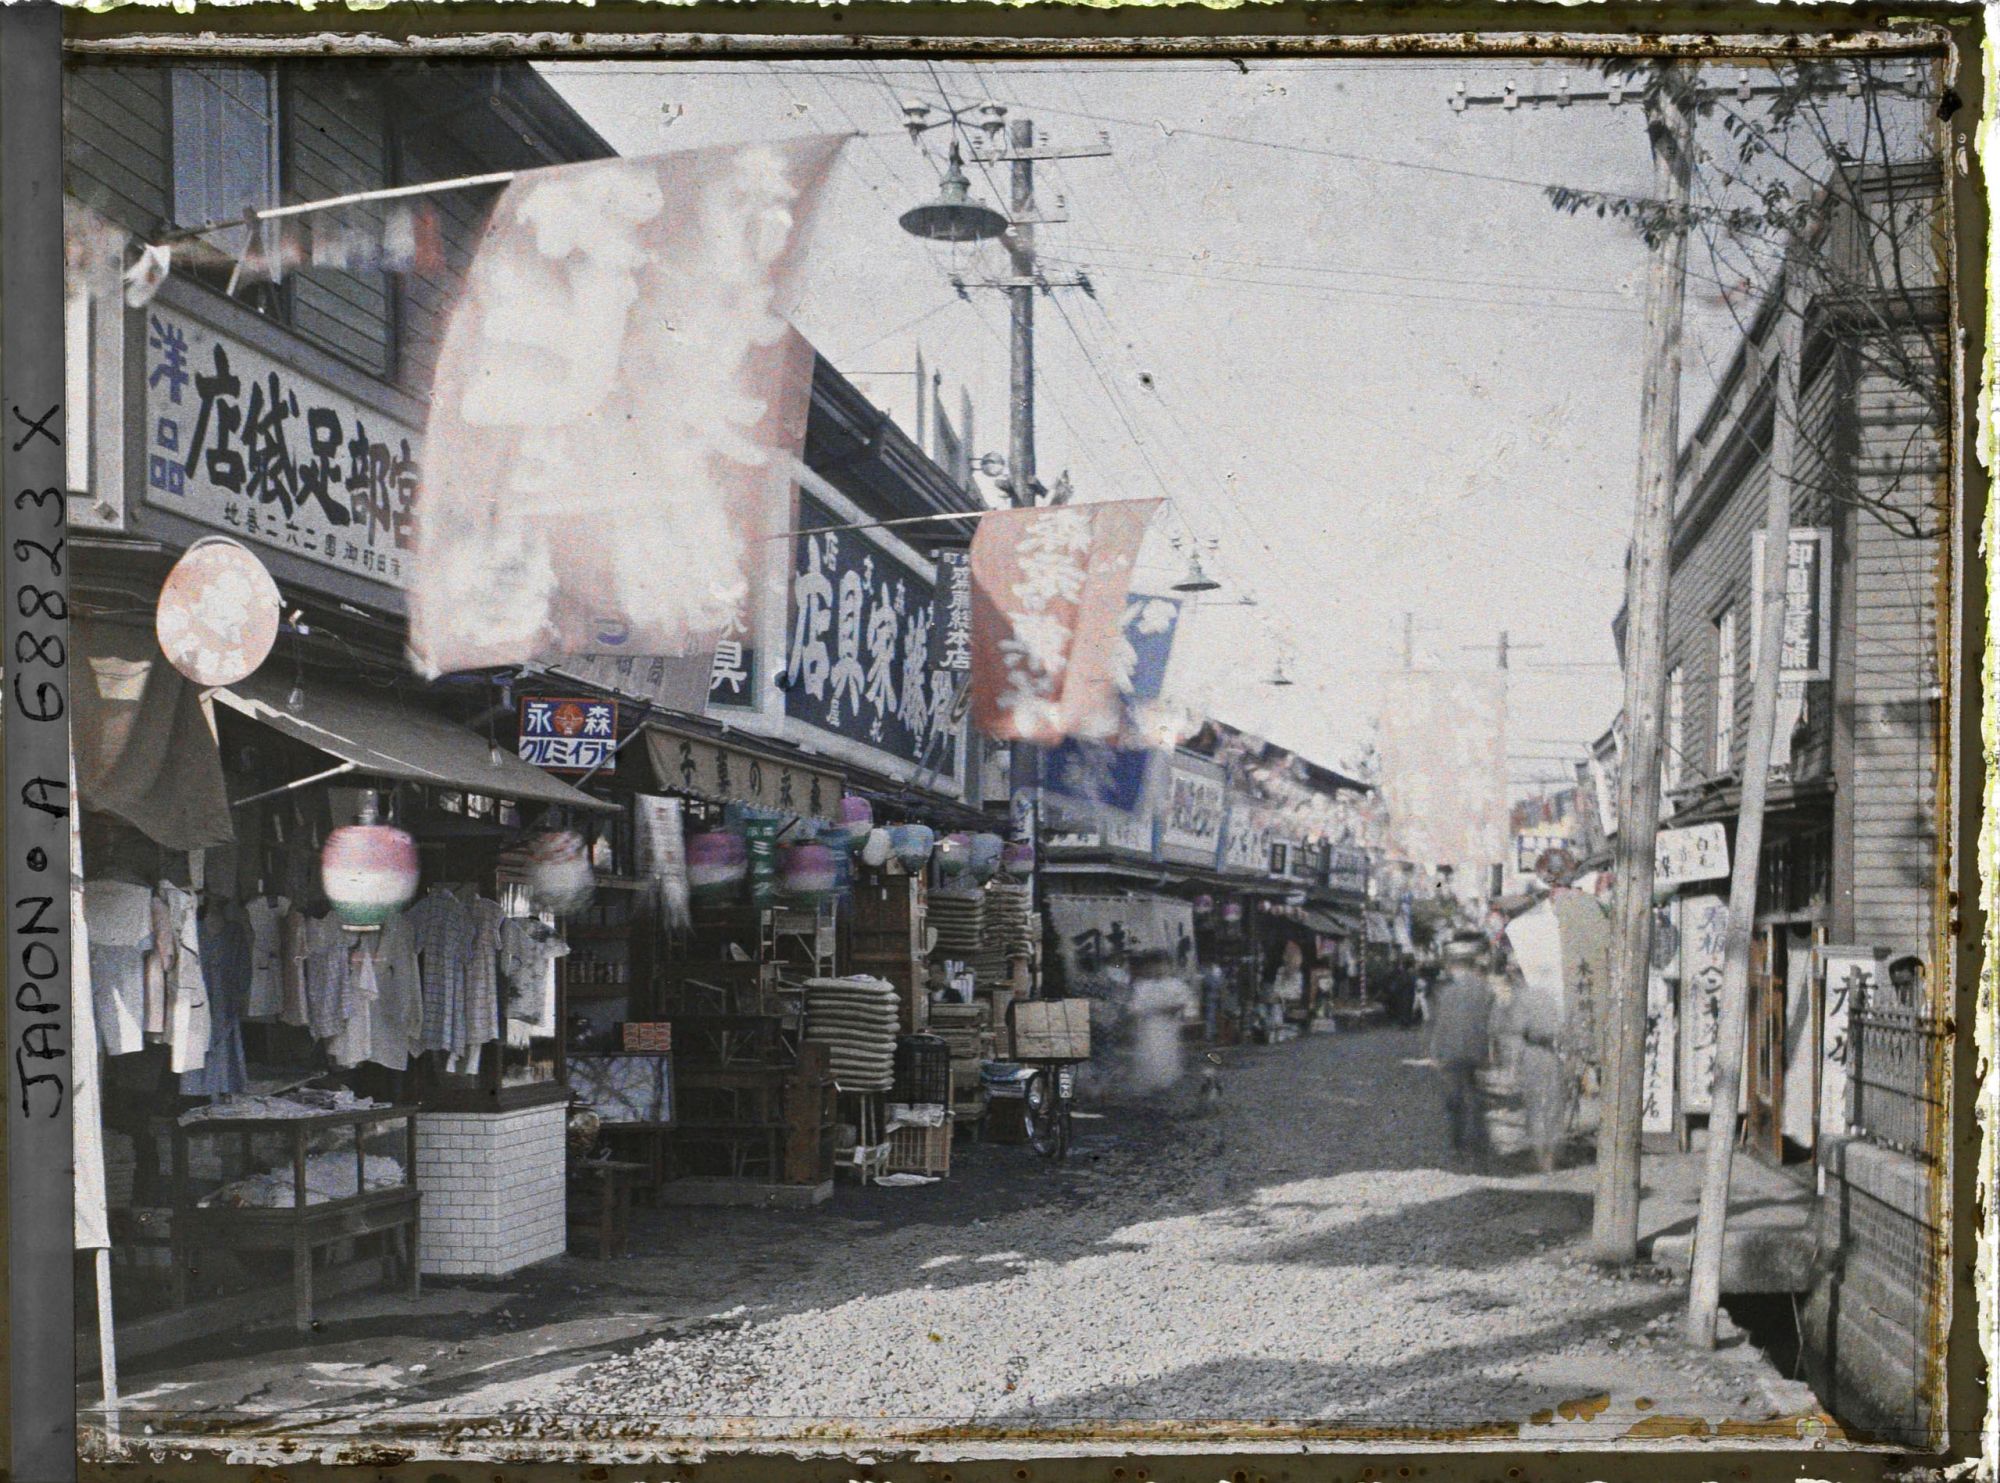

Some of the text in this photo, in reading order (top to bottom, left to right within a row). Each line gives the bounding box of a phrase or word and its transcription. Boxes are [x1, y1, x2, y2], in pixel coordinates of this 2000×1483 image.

[13, 402, 62, 447] X
[148, 314, 189, 497] 洋品
[13, 487, 67, 722] 68823
[526, 702, 611, 737] 森永
[15, 896, 65, 1119] JAPON
